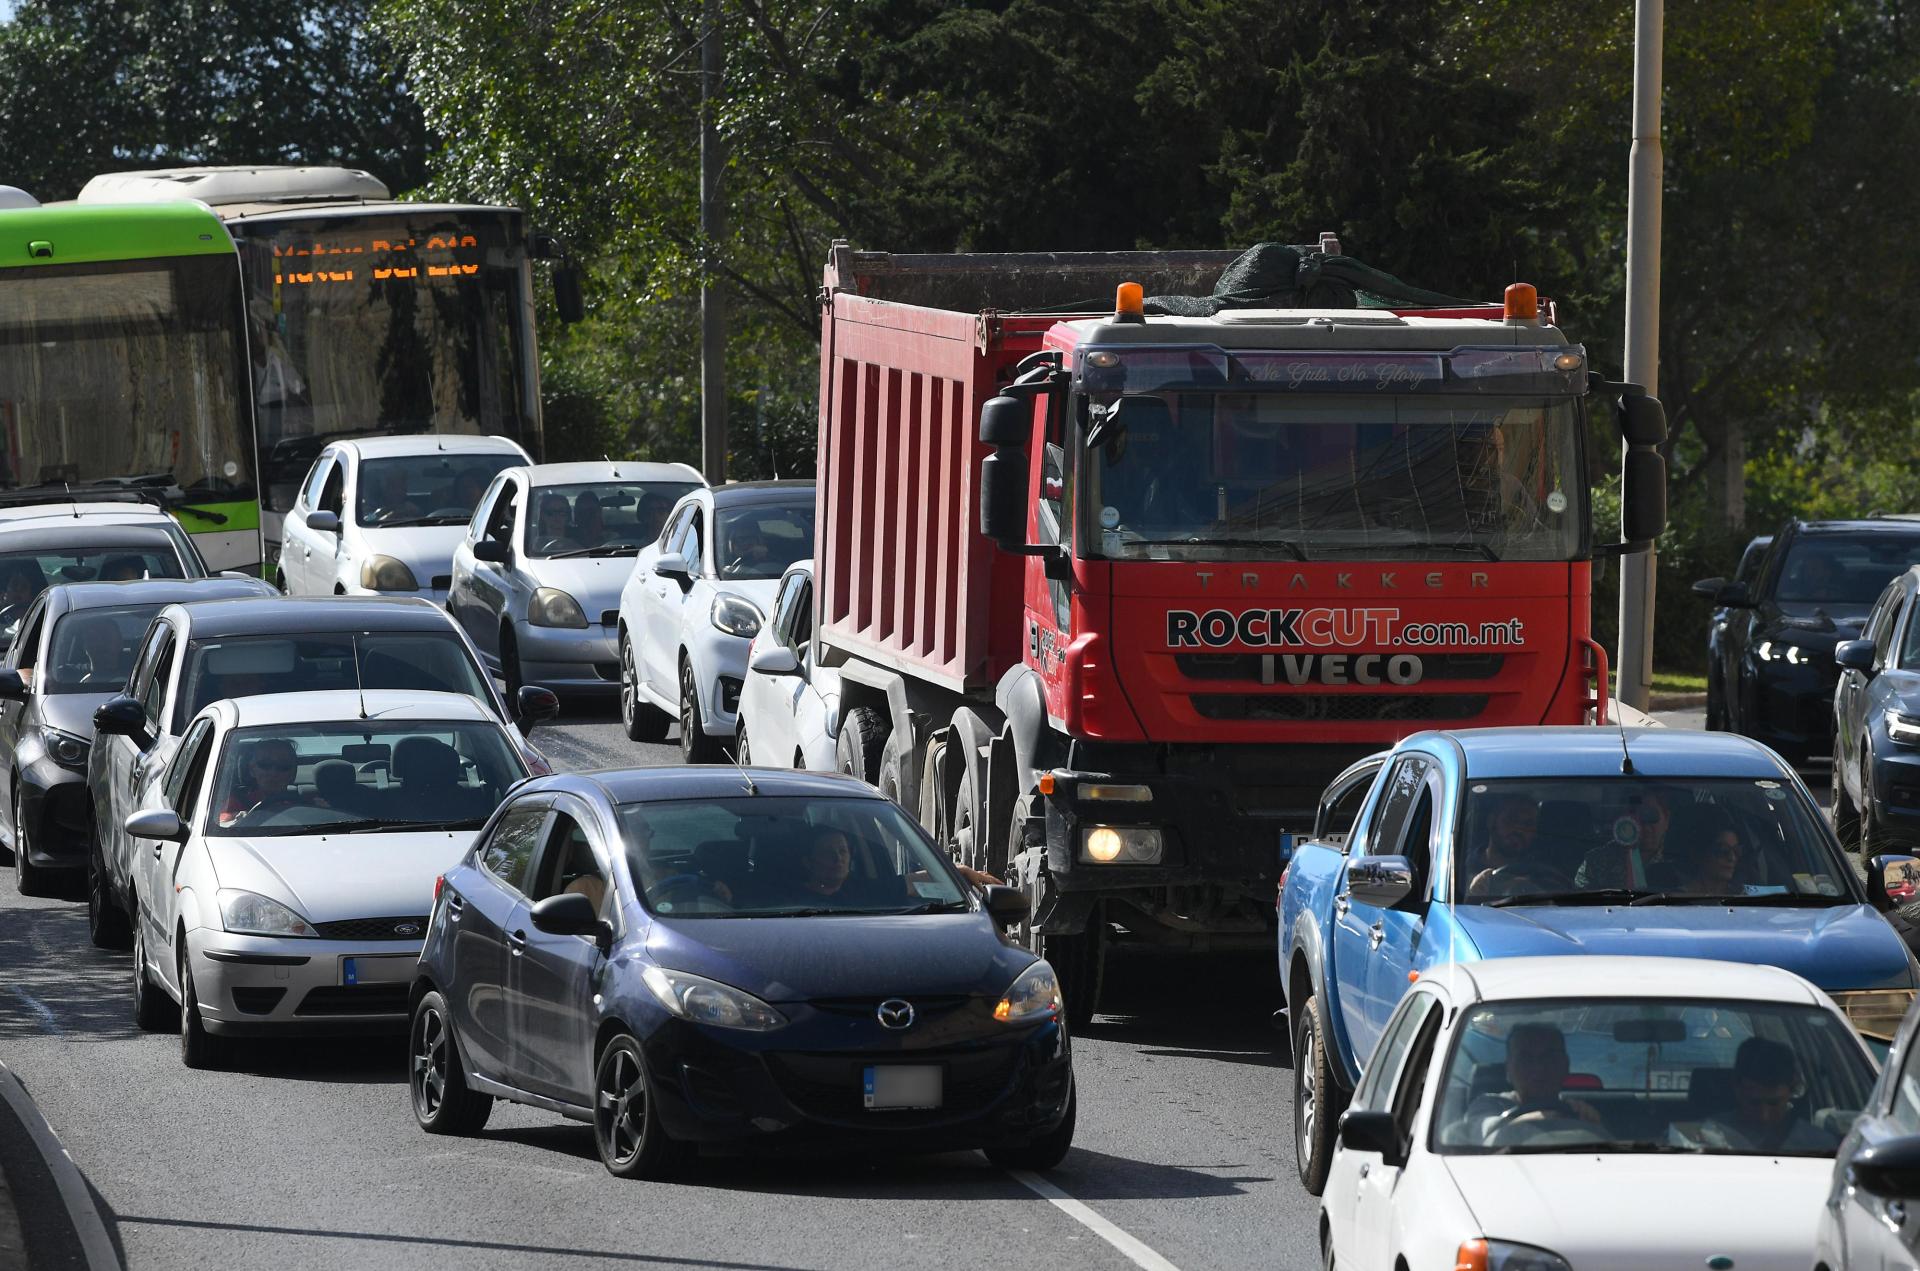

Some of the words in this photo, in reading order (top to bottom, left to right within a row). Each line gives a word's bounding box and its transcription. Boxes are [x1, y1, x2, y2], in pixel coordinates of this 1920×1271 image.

[1336, 362, 1369, 382] No
[1196, 572, 1491, 588] TRAKKER
[1166, 608, 1525, 647] ROCKCUT.com.mt
[1261, 654, 1424, 686] IVECO
